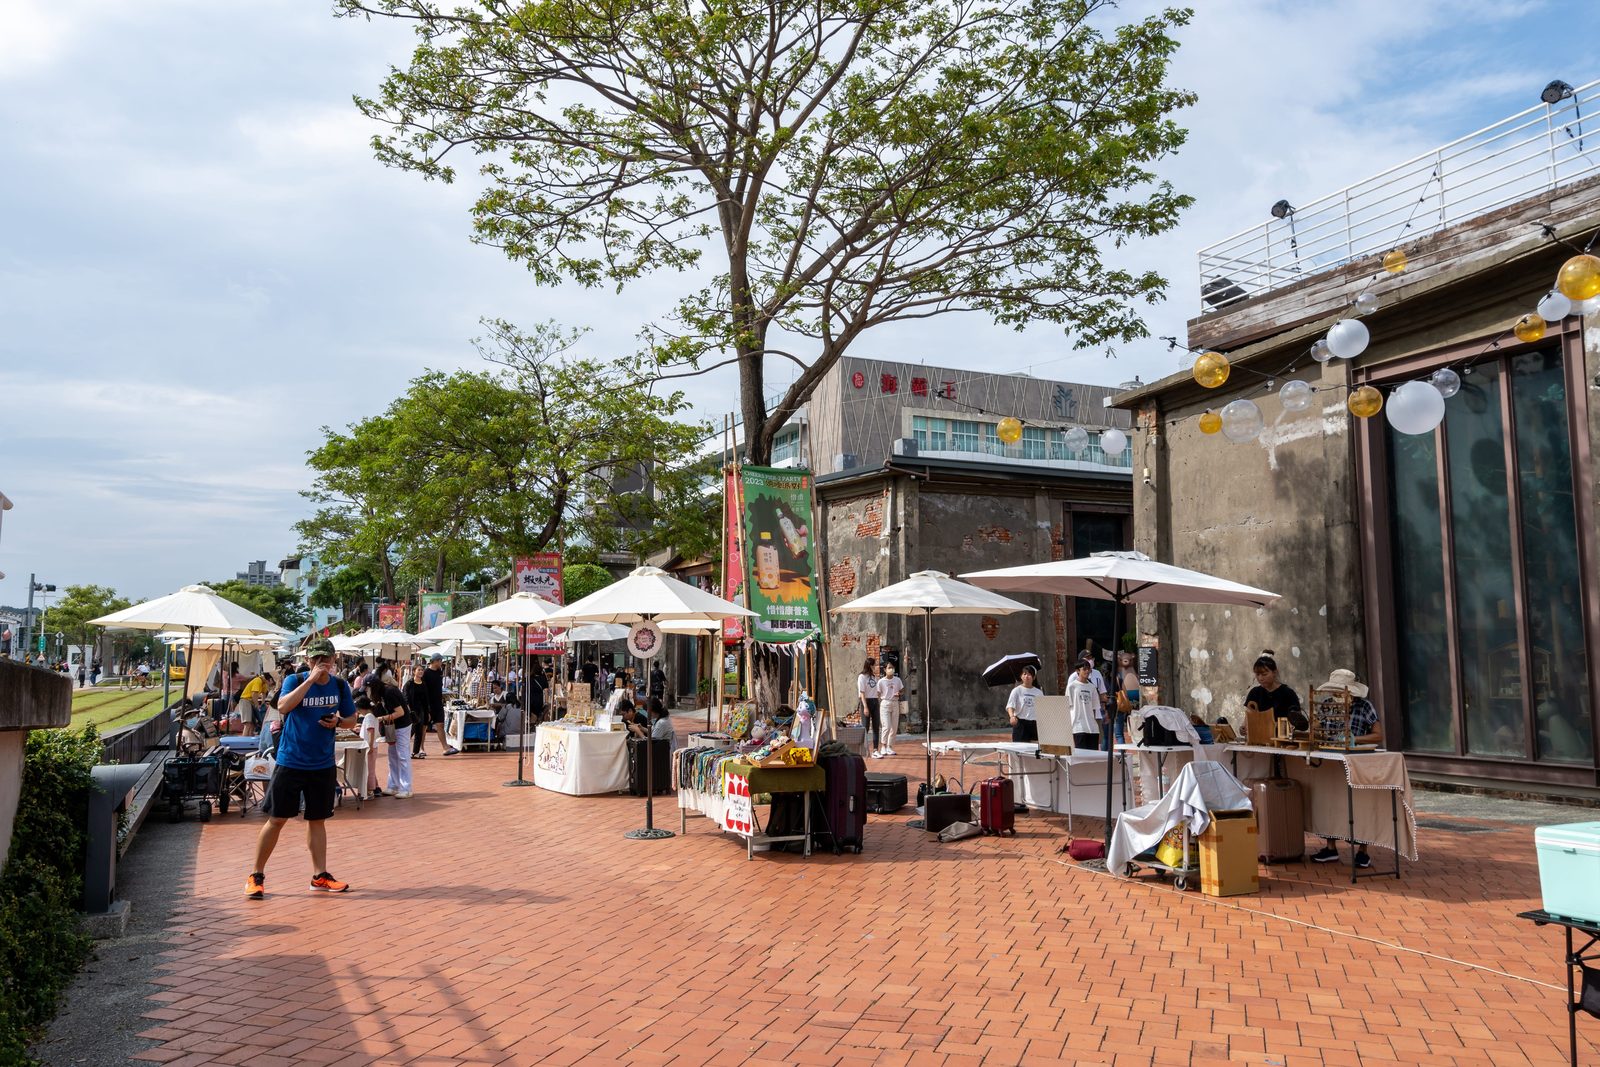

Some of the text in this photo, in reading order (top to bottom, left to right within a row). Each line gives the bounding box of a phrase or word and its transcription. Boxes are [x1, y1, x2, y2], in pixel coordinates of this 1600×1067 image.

[881, 373, 957, 400] 海霸王
[744, 477, 764, 486] 2023
[302, 695, 339, 707] HOUSTON
